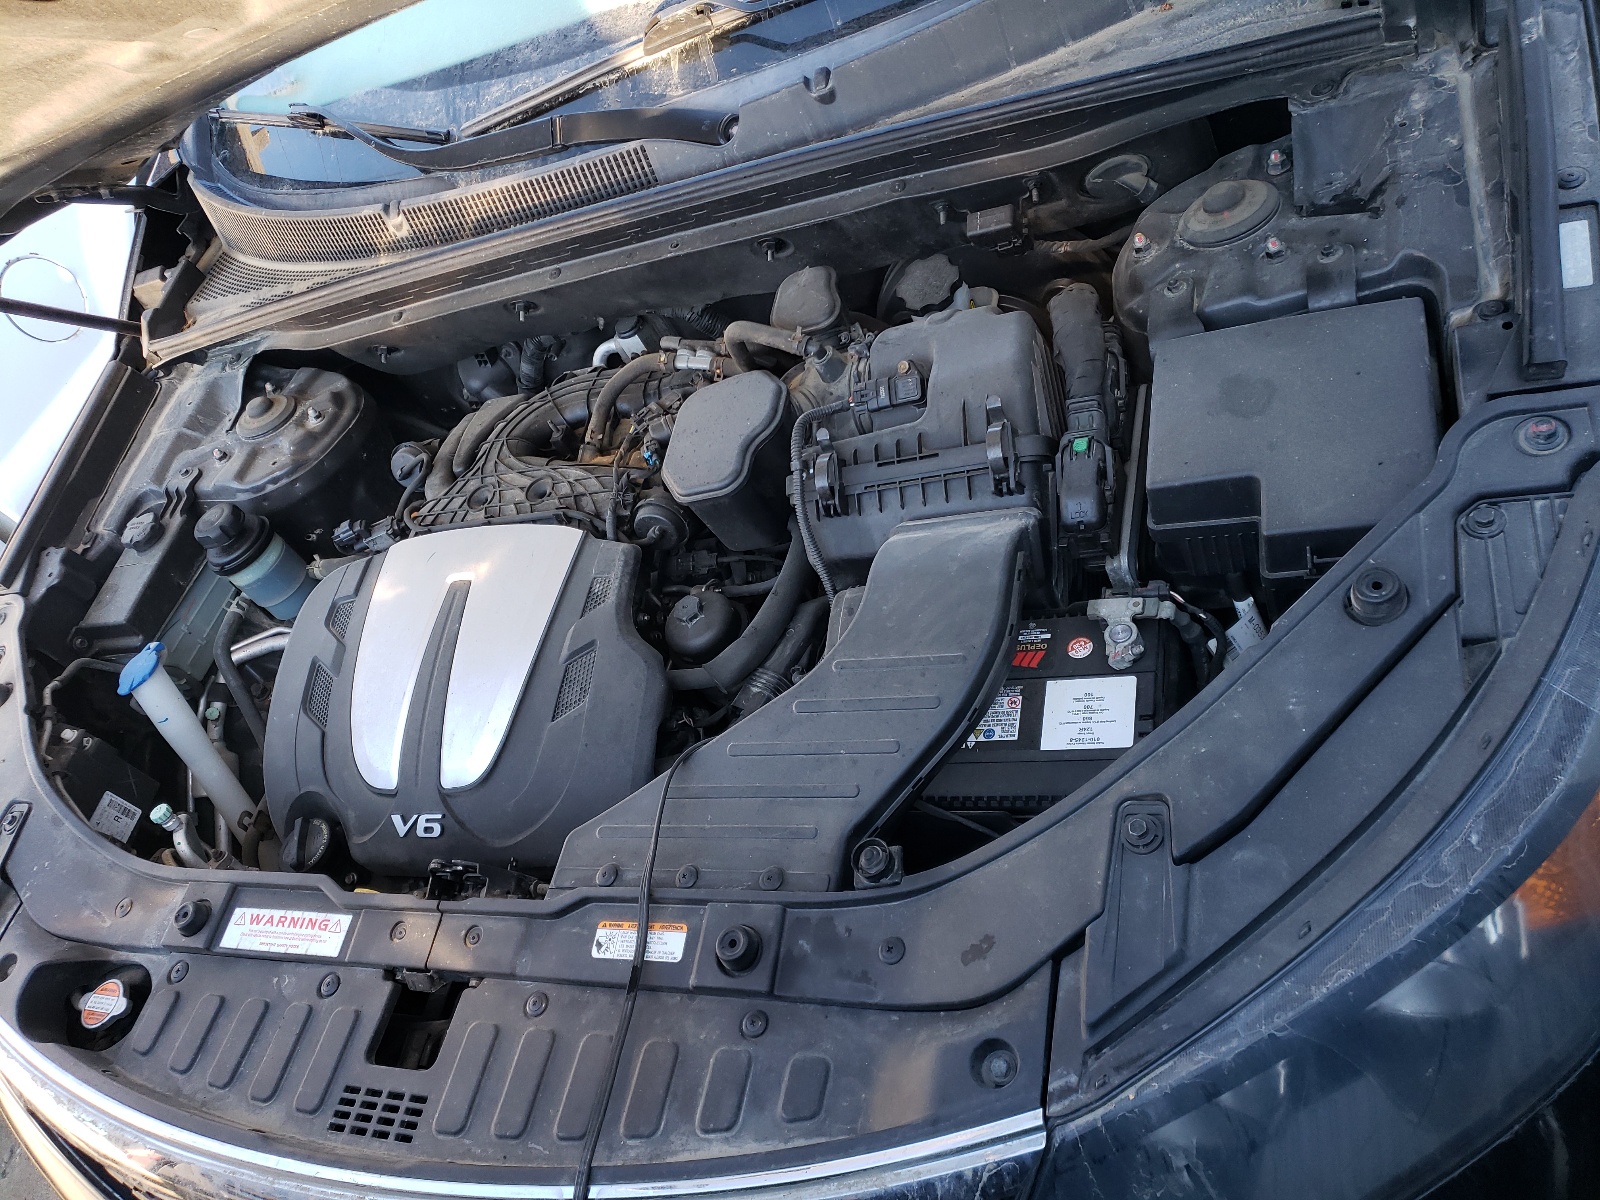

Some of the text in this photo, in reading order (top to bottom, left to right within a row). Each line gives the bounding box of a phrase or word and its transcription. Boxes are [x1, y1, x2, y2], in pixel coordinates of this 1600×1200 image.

[1070, 510, 1089, 520] LOCK
[390, 813, 445, 838] V6
[249, 913, 330, 932] WARNING
